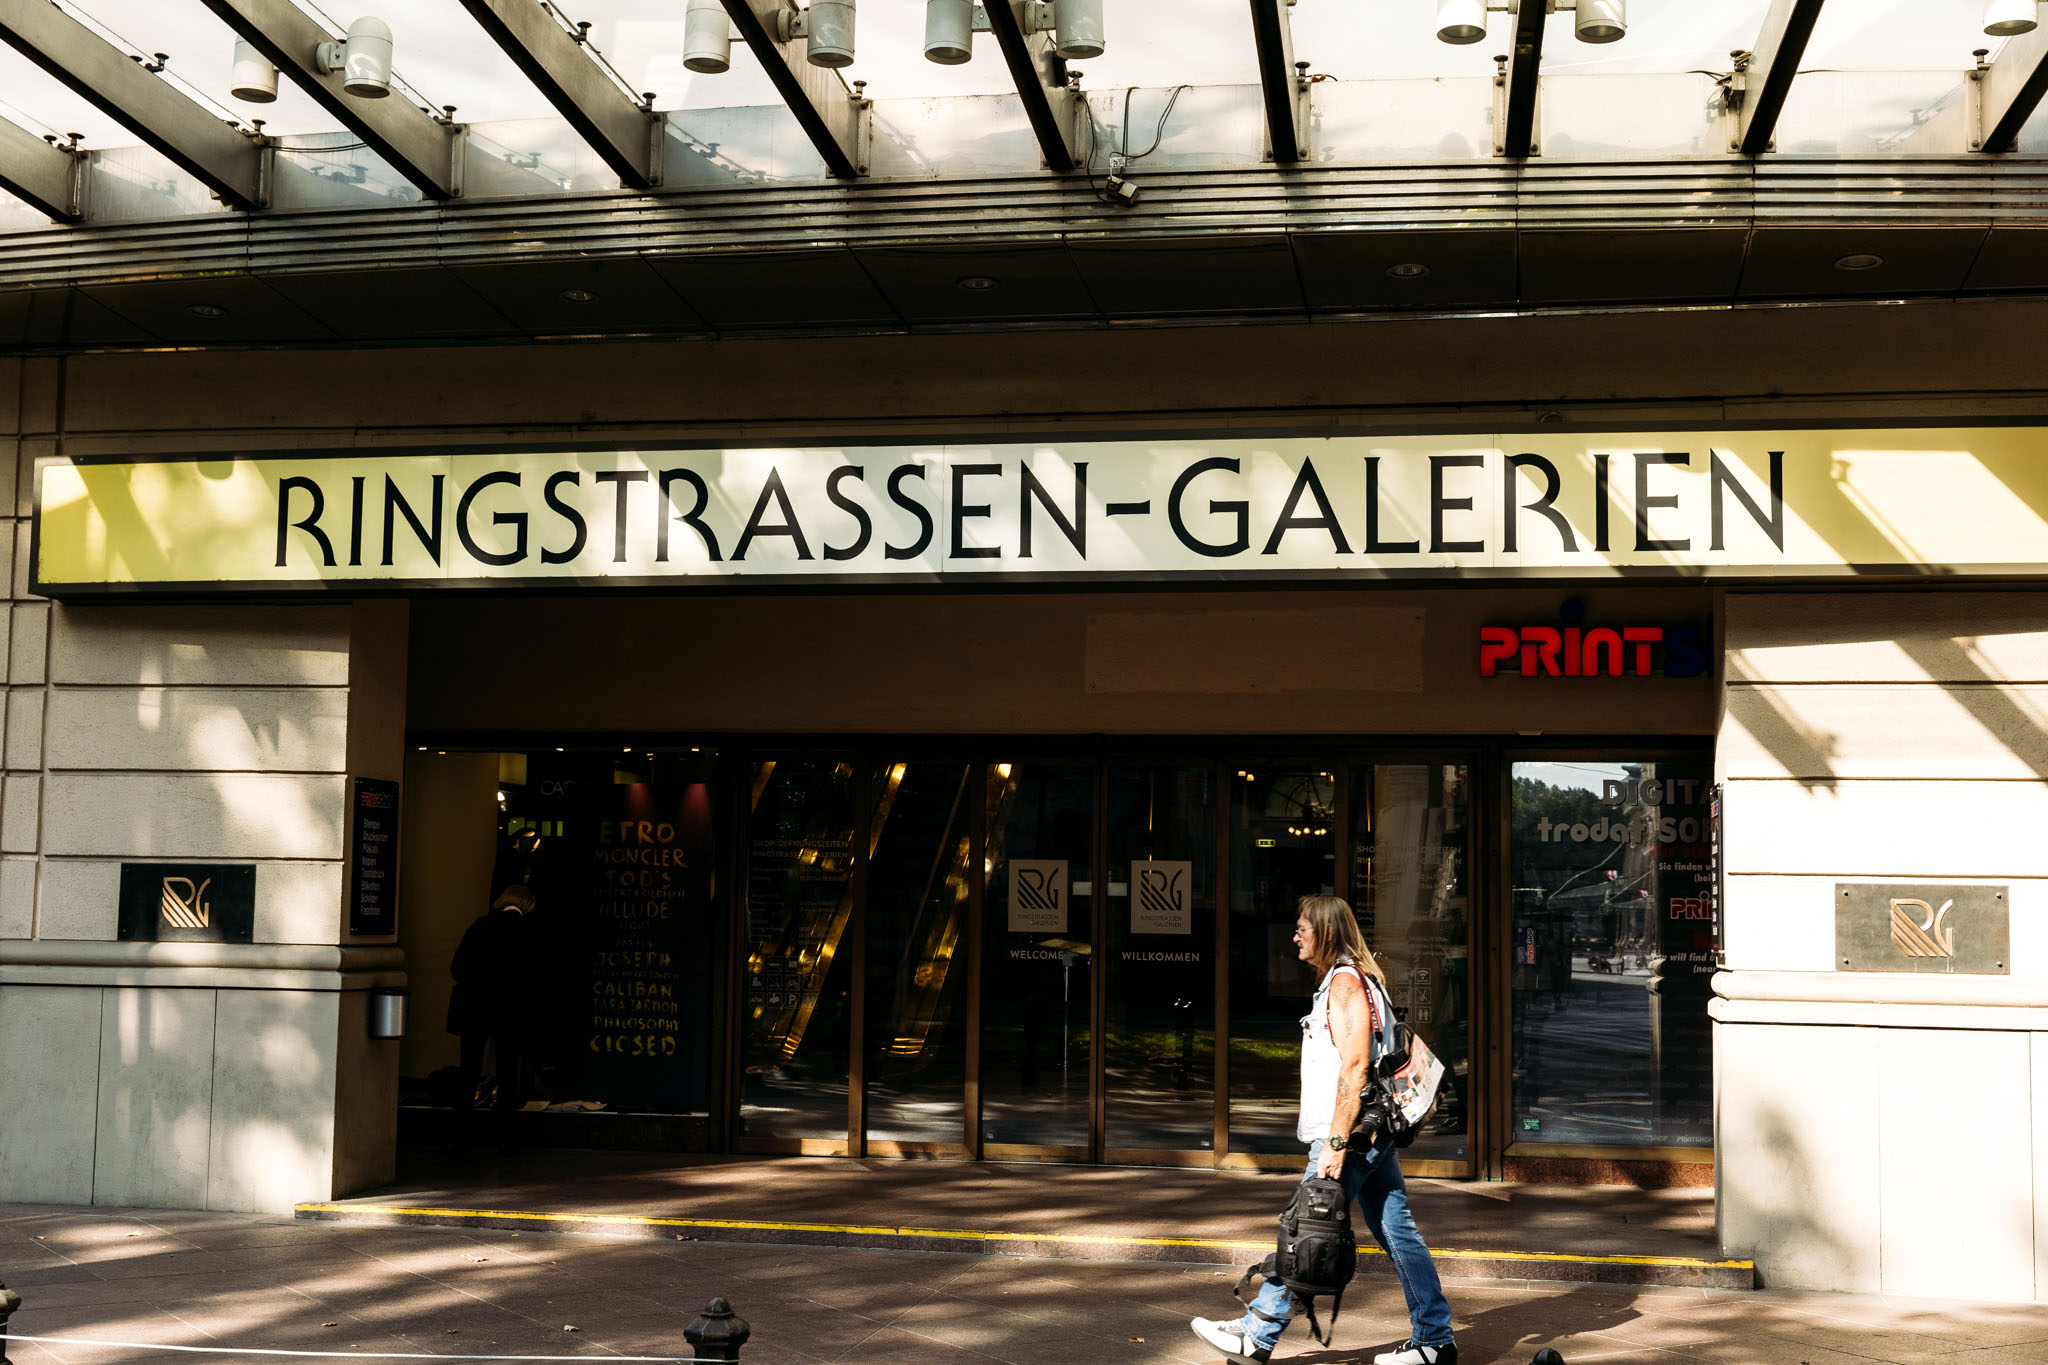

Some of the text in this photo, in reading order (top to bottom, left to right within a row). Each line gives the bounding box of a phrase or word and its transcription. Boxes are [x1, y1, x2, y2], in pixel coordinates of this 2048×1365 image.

[275, 449, 1785, 568] RINGSTRASSEN-GALERIEN
[600, 820, 675, 845] ETRO
[1538, 816, 1649, 843] trodat
[592, 847, 689, 869] MONCLER
[1658, 862, 1671, 871] Sie
[1674, 862, 1703, 871] finden
[1009, 949, 1064, 960] WELCOME
[1121, 951, 1201, 962] WILLKOMMEN
[1670, 953, 1687, 962] will
[1688, 953, 1707, 962] find
[592, 980, 672, 998] CALIBAN
[594, 1015, 680, 1031] PHILOSOPHY
